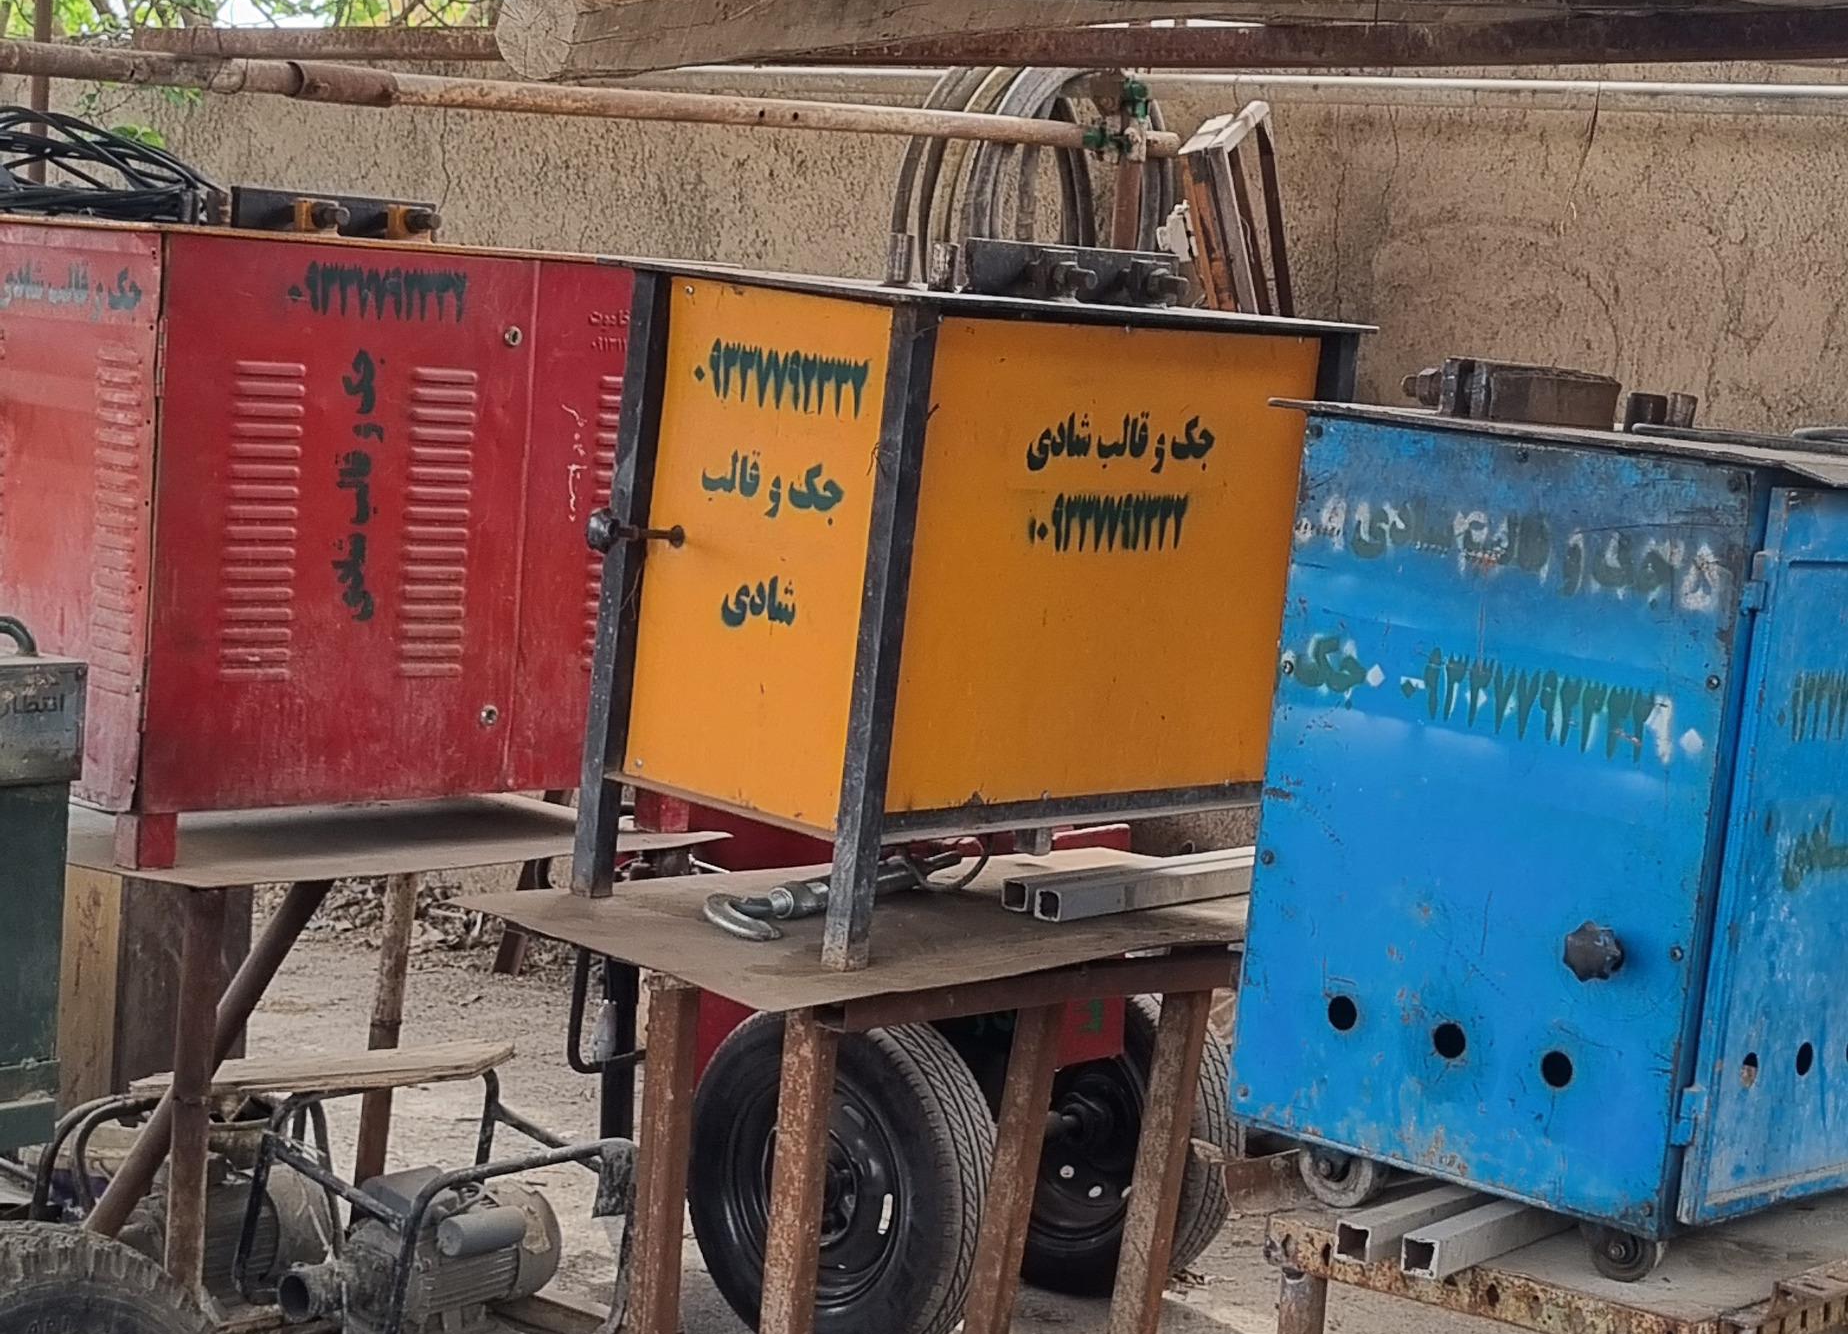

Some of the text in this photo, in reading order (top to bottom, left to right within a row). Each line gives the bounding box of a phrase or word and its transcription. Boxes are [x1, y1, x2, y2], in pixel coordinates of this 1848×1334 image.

[694, 337, 868, 420] ۰۹۳۳۷۷۹۲۳۳۲
[1026, 411, 1216, 474] جک و قالب شادی
[332, 348, 386, 622] جک و قالب شادی
[702, 449, 845, 527] جک و قالب
[721, 574, 796, 628] شادی
